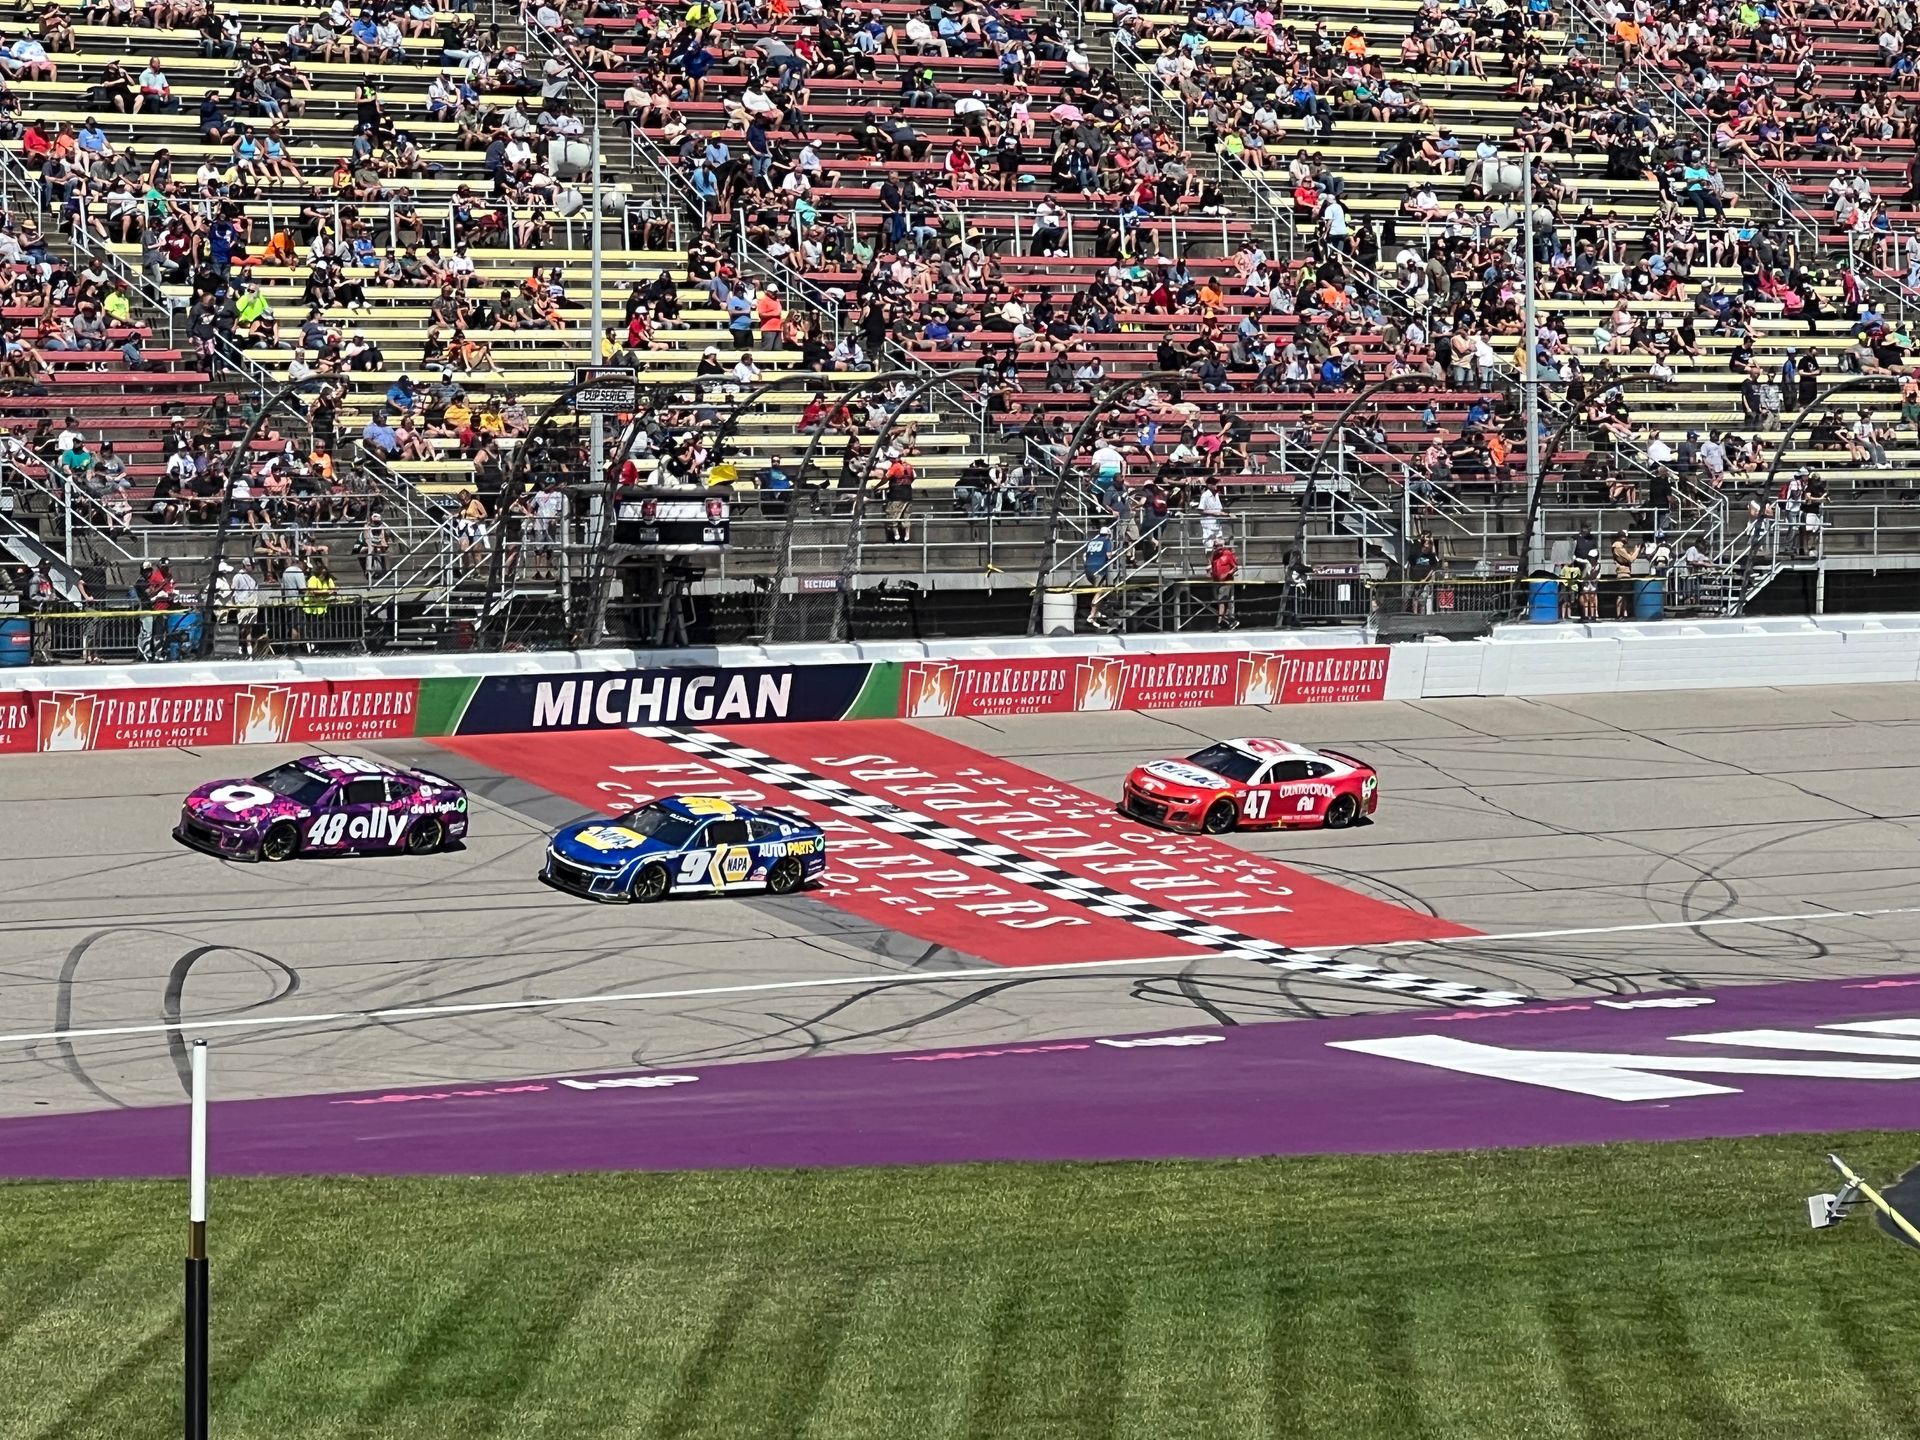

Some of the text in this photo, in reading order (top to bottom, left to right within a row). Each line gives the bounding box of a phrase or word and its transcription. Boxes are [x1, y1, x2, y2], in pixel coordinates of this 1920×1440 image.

[804, 580, 836, 588] SECTION
[1138, 689, 1215, 702] CASINO HOTEL
[1297, 685, 1371, 695] CASINO HOTEL
[532, 673, 793, 727] MICHIGAN
[973, 695, 1052, 707] CASINO HOTEL
[116, 726, 208, 739] CASINO HOTEL
[308, 719, 397, 732] CASINO HOTEL
[955, 768, 1095, 819] HOTEL
[410, 804, 424, 814] do
[1243, 790, 1271, 819] 47
[307, 812, 348, 846] 48
[349, 806, 409, 846] ally
[758, 840, 815, 858] AUTO PARTS
[676, 851, 712, 884] 9
[727, 857, 748, 872] NAPA
[1120, 832, 1294, 896] CASINO
